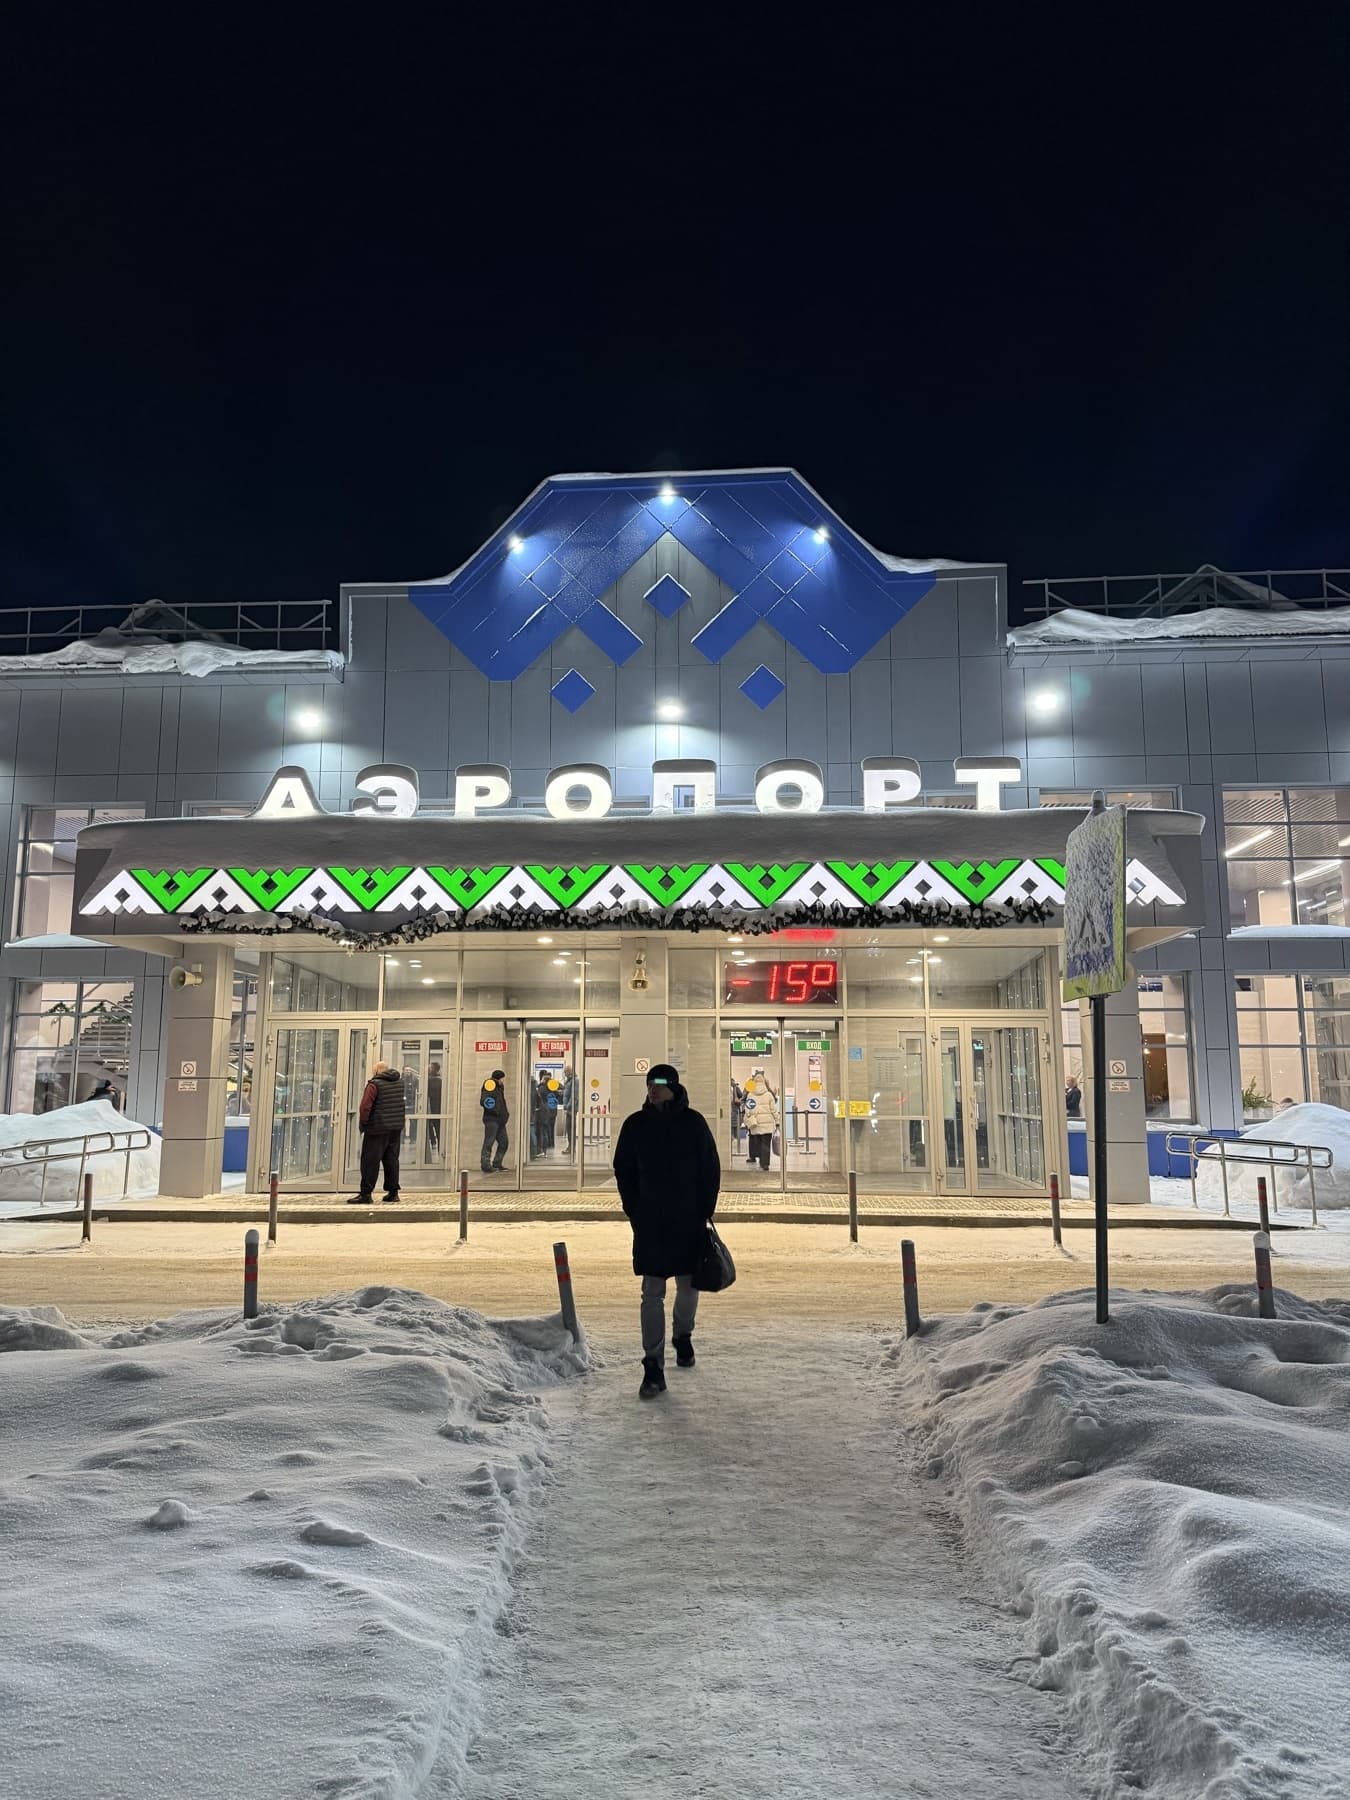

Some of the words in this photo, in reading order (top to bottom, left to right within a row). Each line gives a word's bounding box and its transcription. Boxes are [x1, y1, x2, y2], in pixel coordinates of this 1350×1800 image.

[253, 764, 1022, 820] АЭРОПОРТ
[478, 1042, 487, 1050] НЕТ
[487, 1042, 503, 1050] ВХОДА
[541, 1042, 550, 1050] НЕТ
[550, 1042, 566, 1050] ВХОДА
[741, 1041, 758, 1050] ВХОД
[806, 1041, 822, 1050] ВХОД
